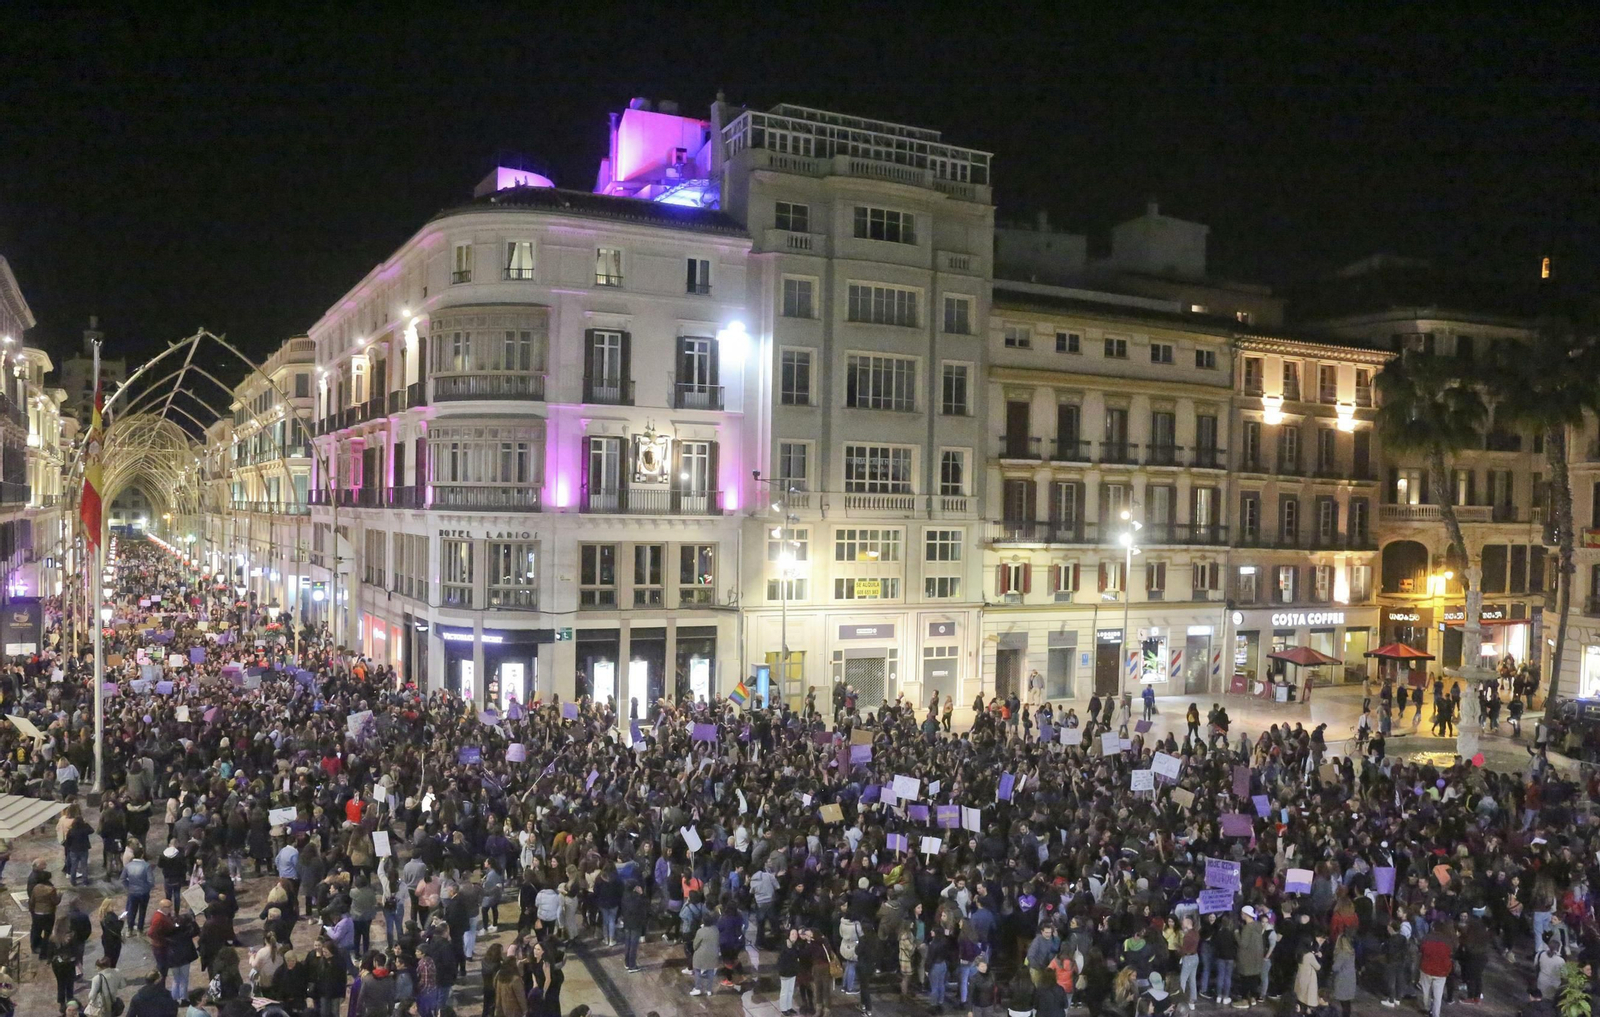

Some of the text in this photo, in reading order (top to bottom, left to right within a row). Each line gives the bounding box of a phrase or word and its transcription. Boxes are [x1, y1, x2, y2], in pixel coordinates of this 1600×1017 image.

[439, 529, 538, 539] HOTEL LARIOS
[1272, 612, 1345, 626] COSTA COFFEE
